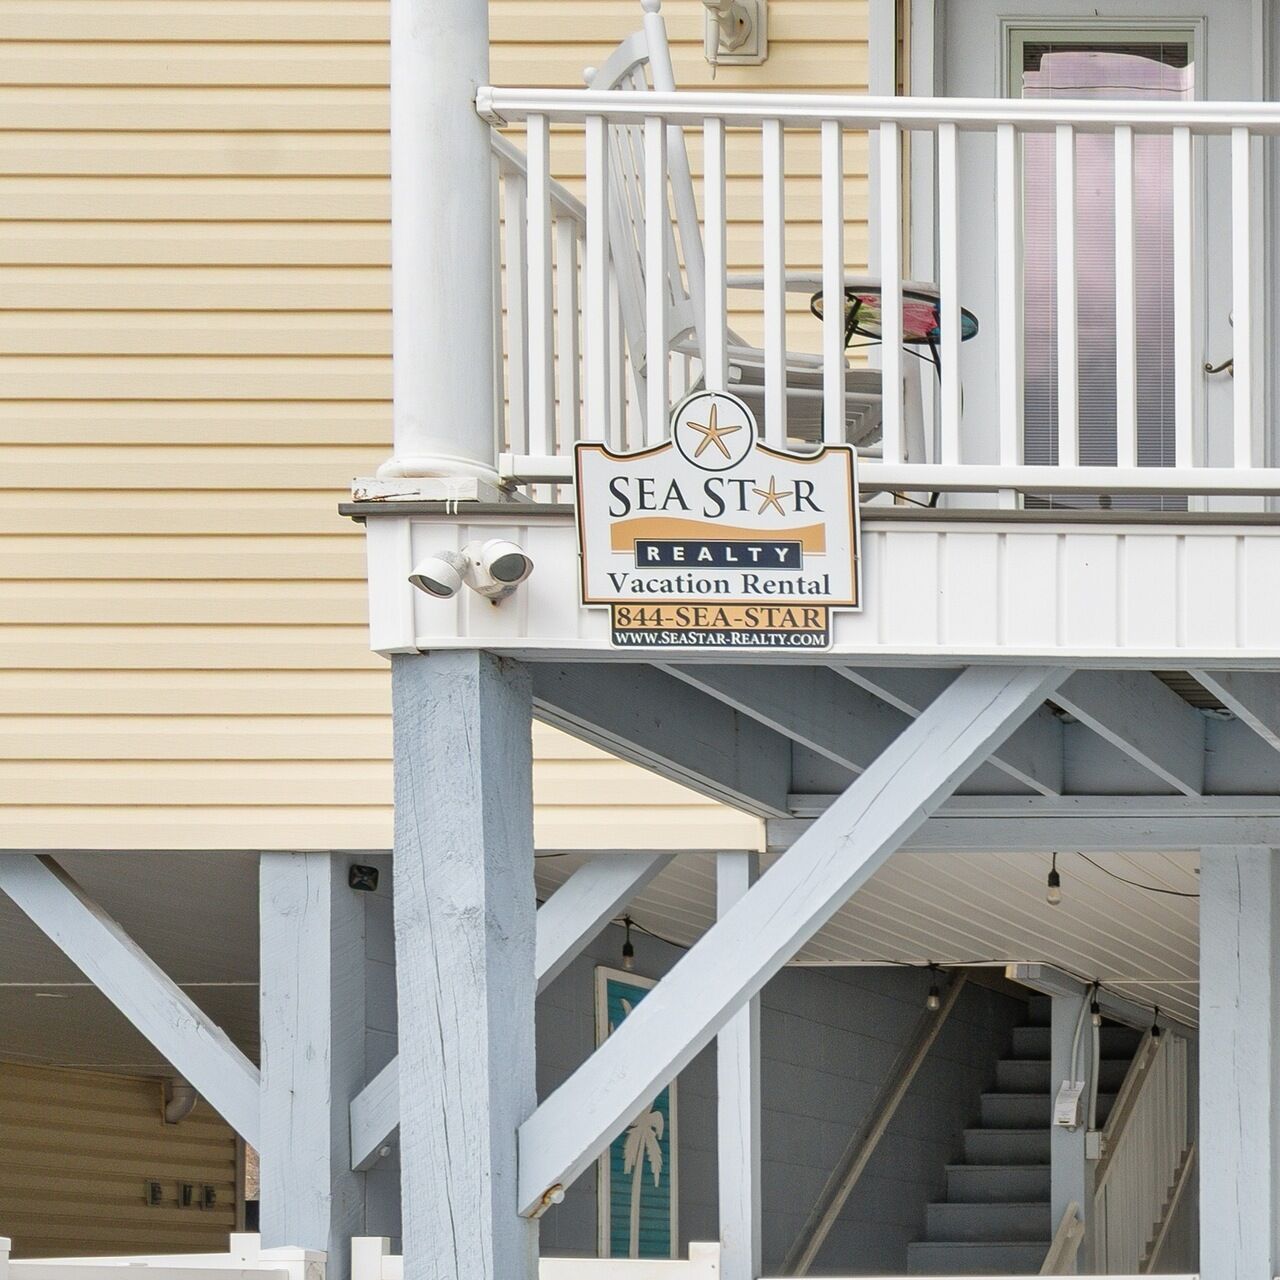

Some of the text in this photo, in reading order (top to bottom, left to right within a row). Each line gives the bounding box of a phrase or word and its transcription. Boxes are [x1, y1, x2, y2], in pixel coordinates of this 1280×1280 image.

[609, 476, 691, 517] SEA
[647, 547, 789, 562] REALTY
[607, 572, 832, 595] Vacation Rental
[617, 606, 822, 628] 844-SEA-STAR
